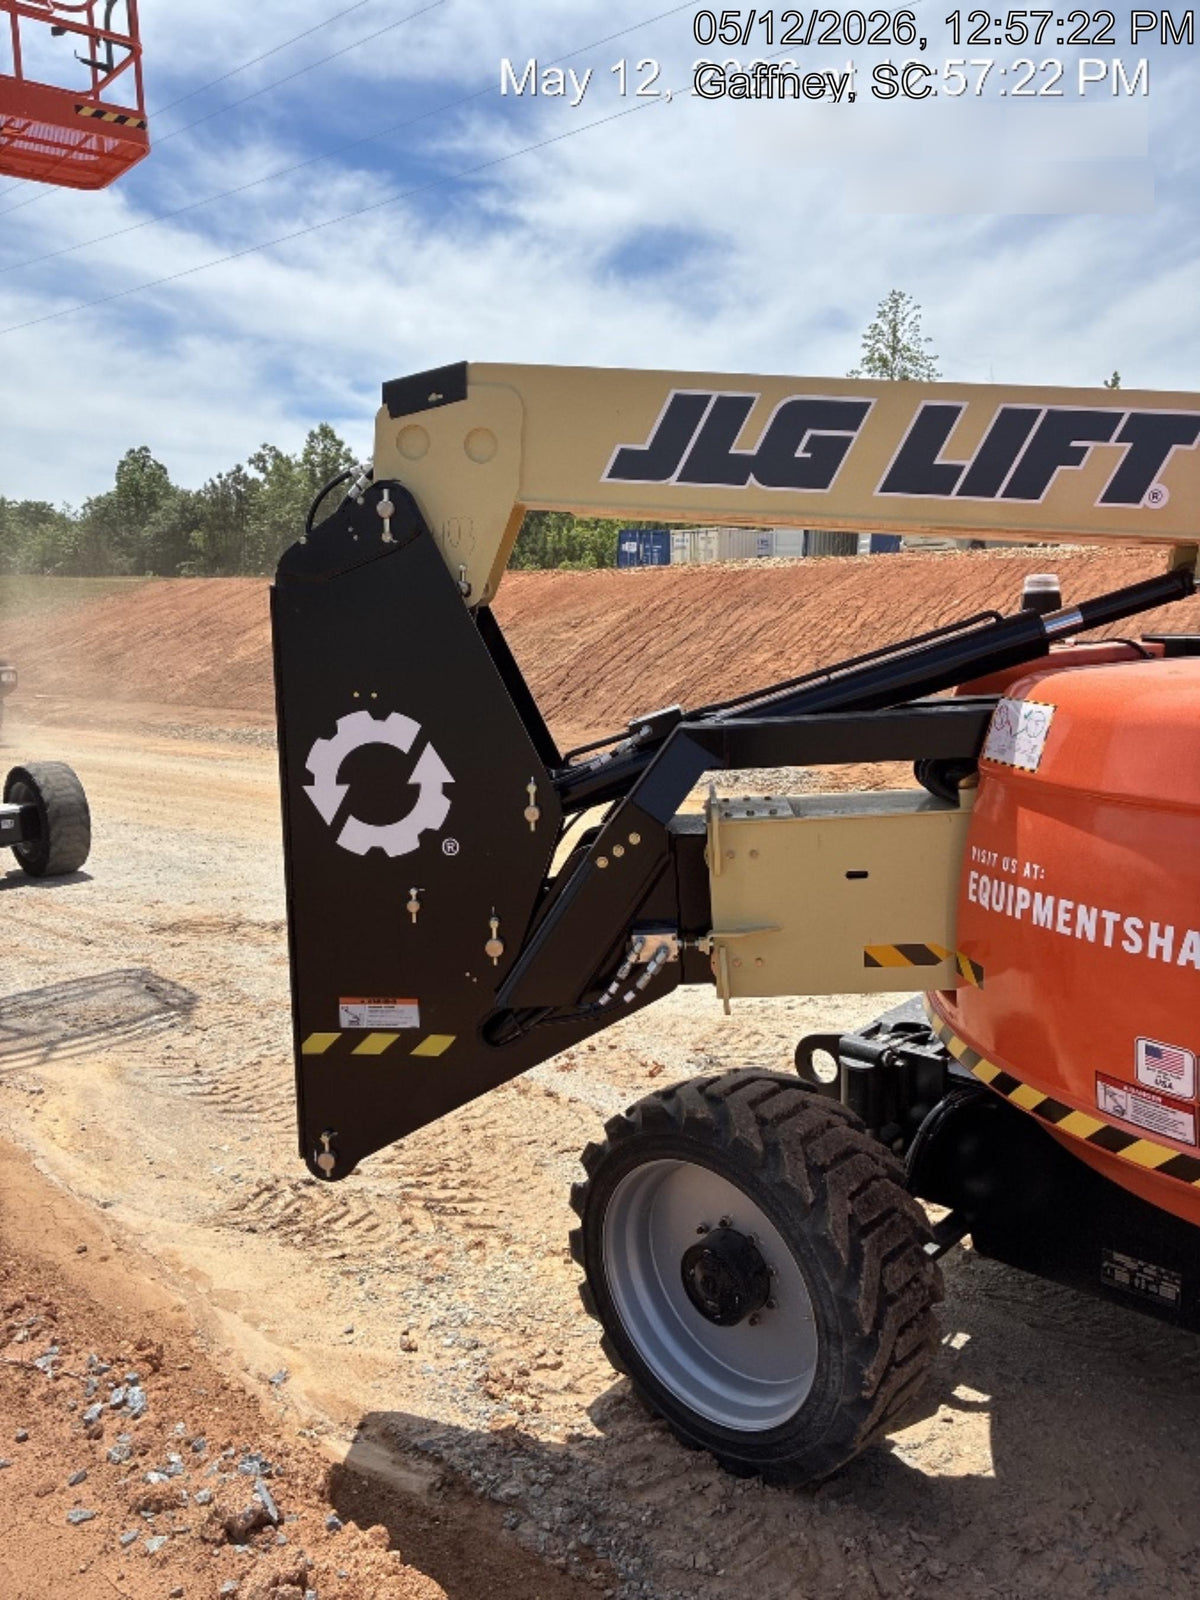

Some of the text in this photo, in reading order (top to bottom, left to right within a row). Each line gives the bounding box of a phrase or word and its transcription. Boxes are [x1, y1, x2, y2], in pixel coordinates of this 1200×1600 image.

[600, 389, 1200, 509] JLG LIFT
[971, 845, 1045, 880] VISIT US AT:
[968, 870, 1200, 971] EQUIPMENTSHA
